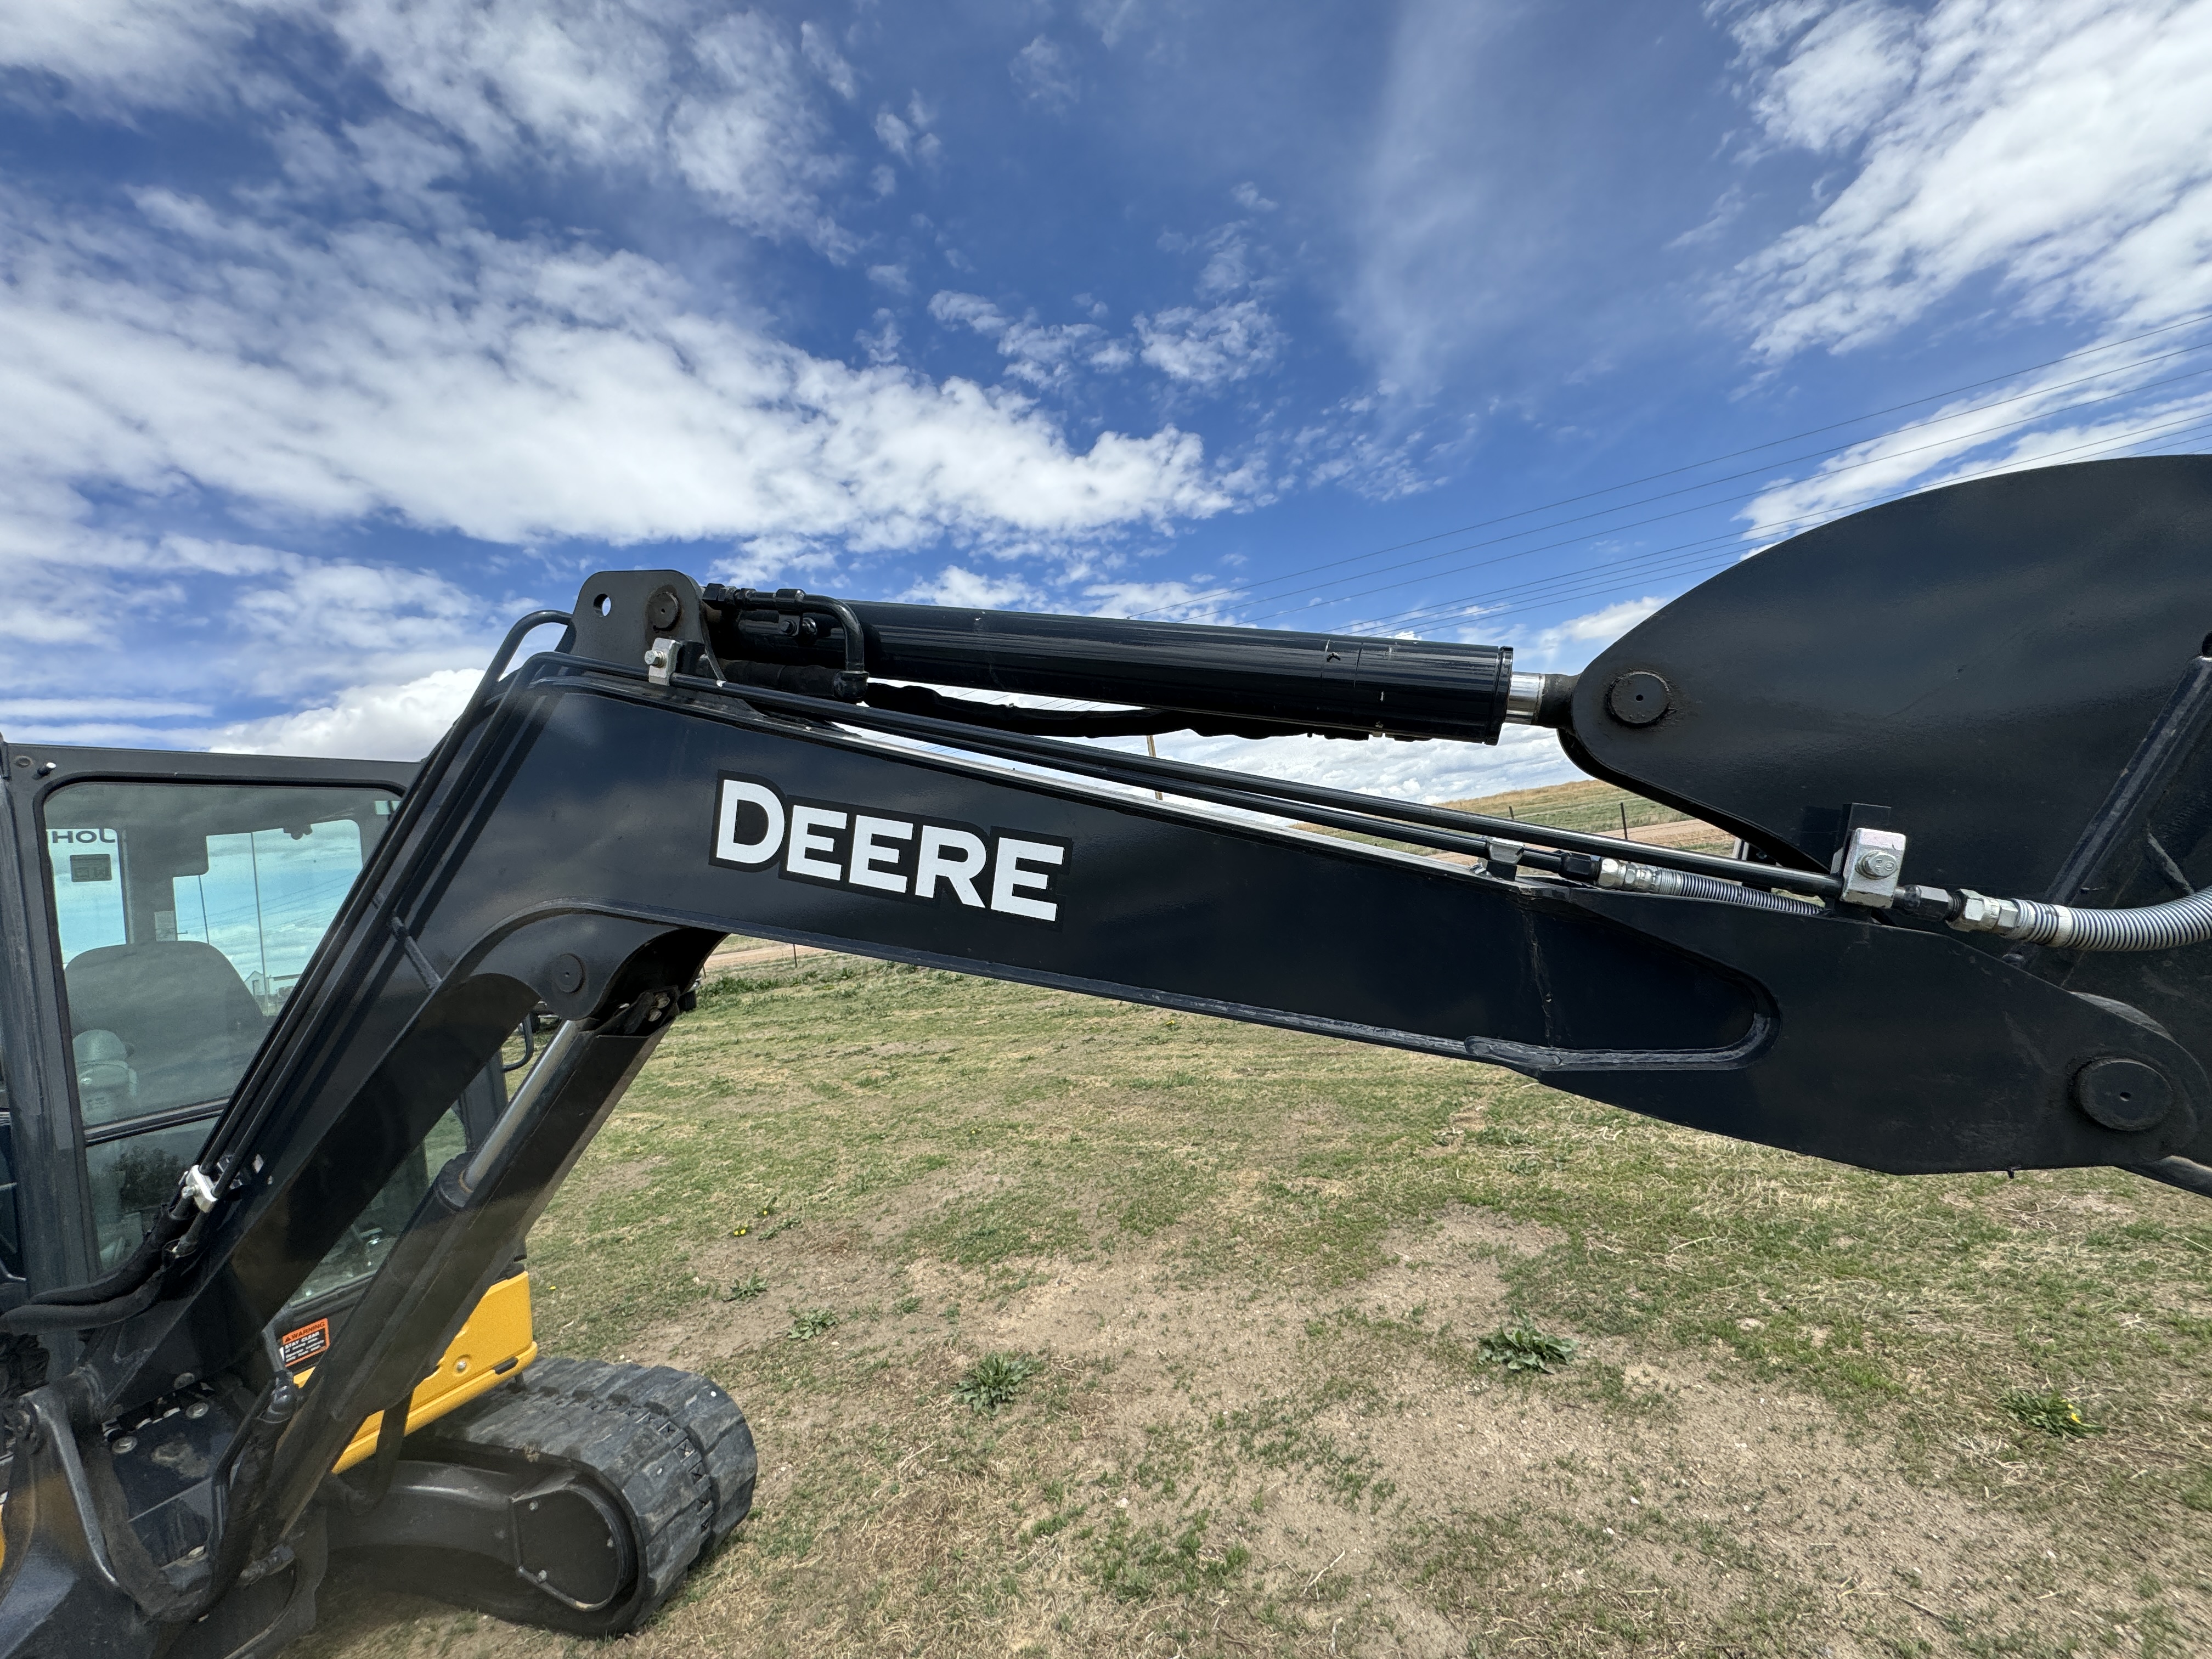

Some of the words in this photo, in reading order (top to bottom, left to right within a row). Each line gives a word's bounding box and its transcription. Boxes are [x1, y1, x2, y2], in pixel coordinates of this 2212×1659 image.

[716, 779, 1064, 922] DEERE
[291, 1322, 325, 1338] WARNING
[285, 1340, 300, 1350] STAY
[301, 1331, 320, 1342] CLEAR
